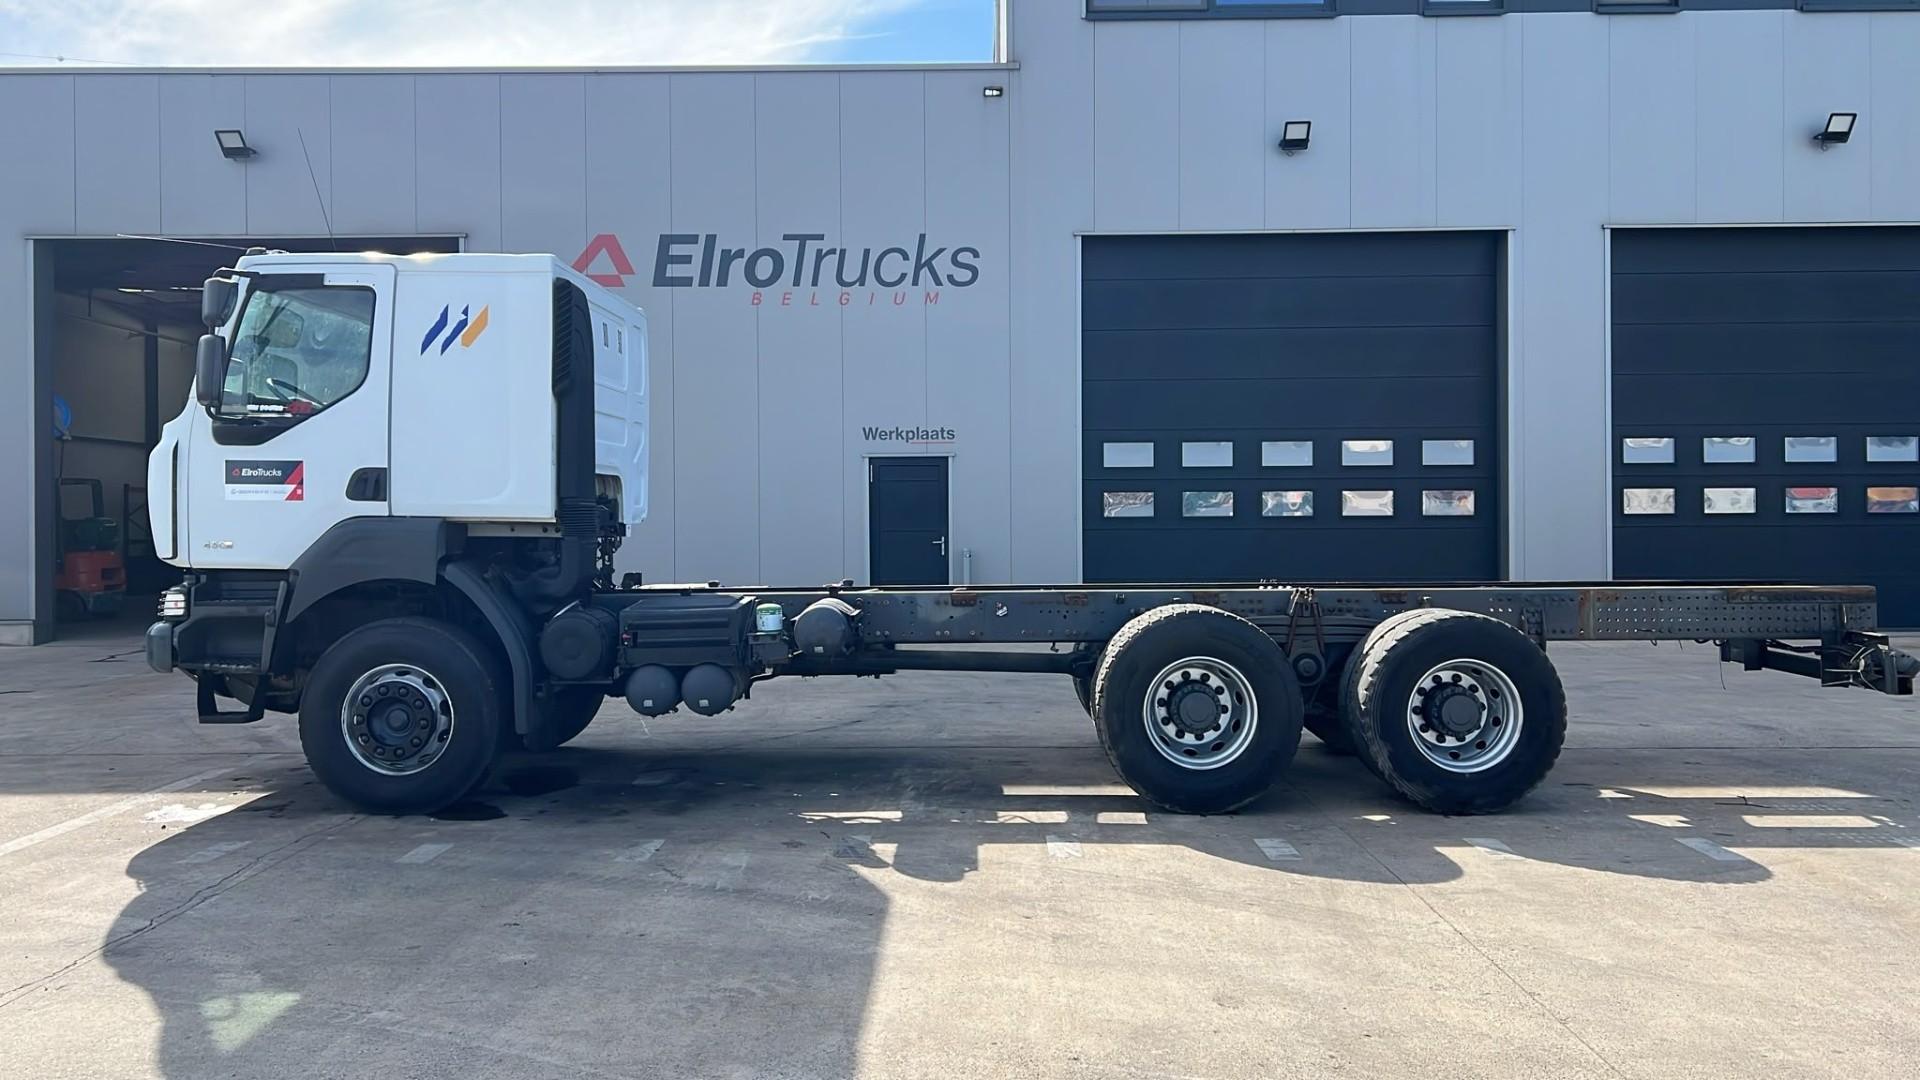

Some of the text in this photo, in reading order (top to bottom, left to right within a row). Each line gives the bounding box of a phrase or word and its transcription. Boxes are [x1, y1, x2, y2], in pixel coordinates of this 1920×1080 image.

[652, 233, 981, 288] ElroTrucks
[750, 291, 939, 306] BELGIUM
[862, 426, 956, 443] Werkplaats
[241, 468, 282, 477] ElroTrucks
